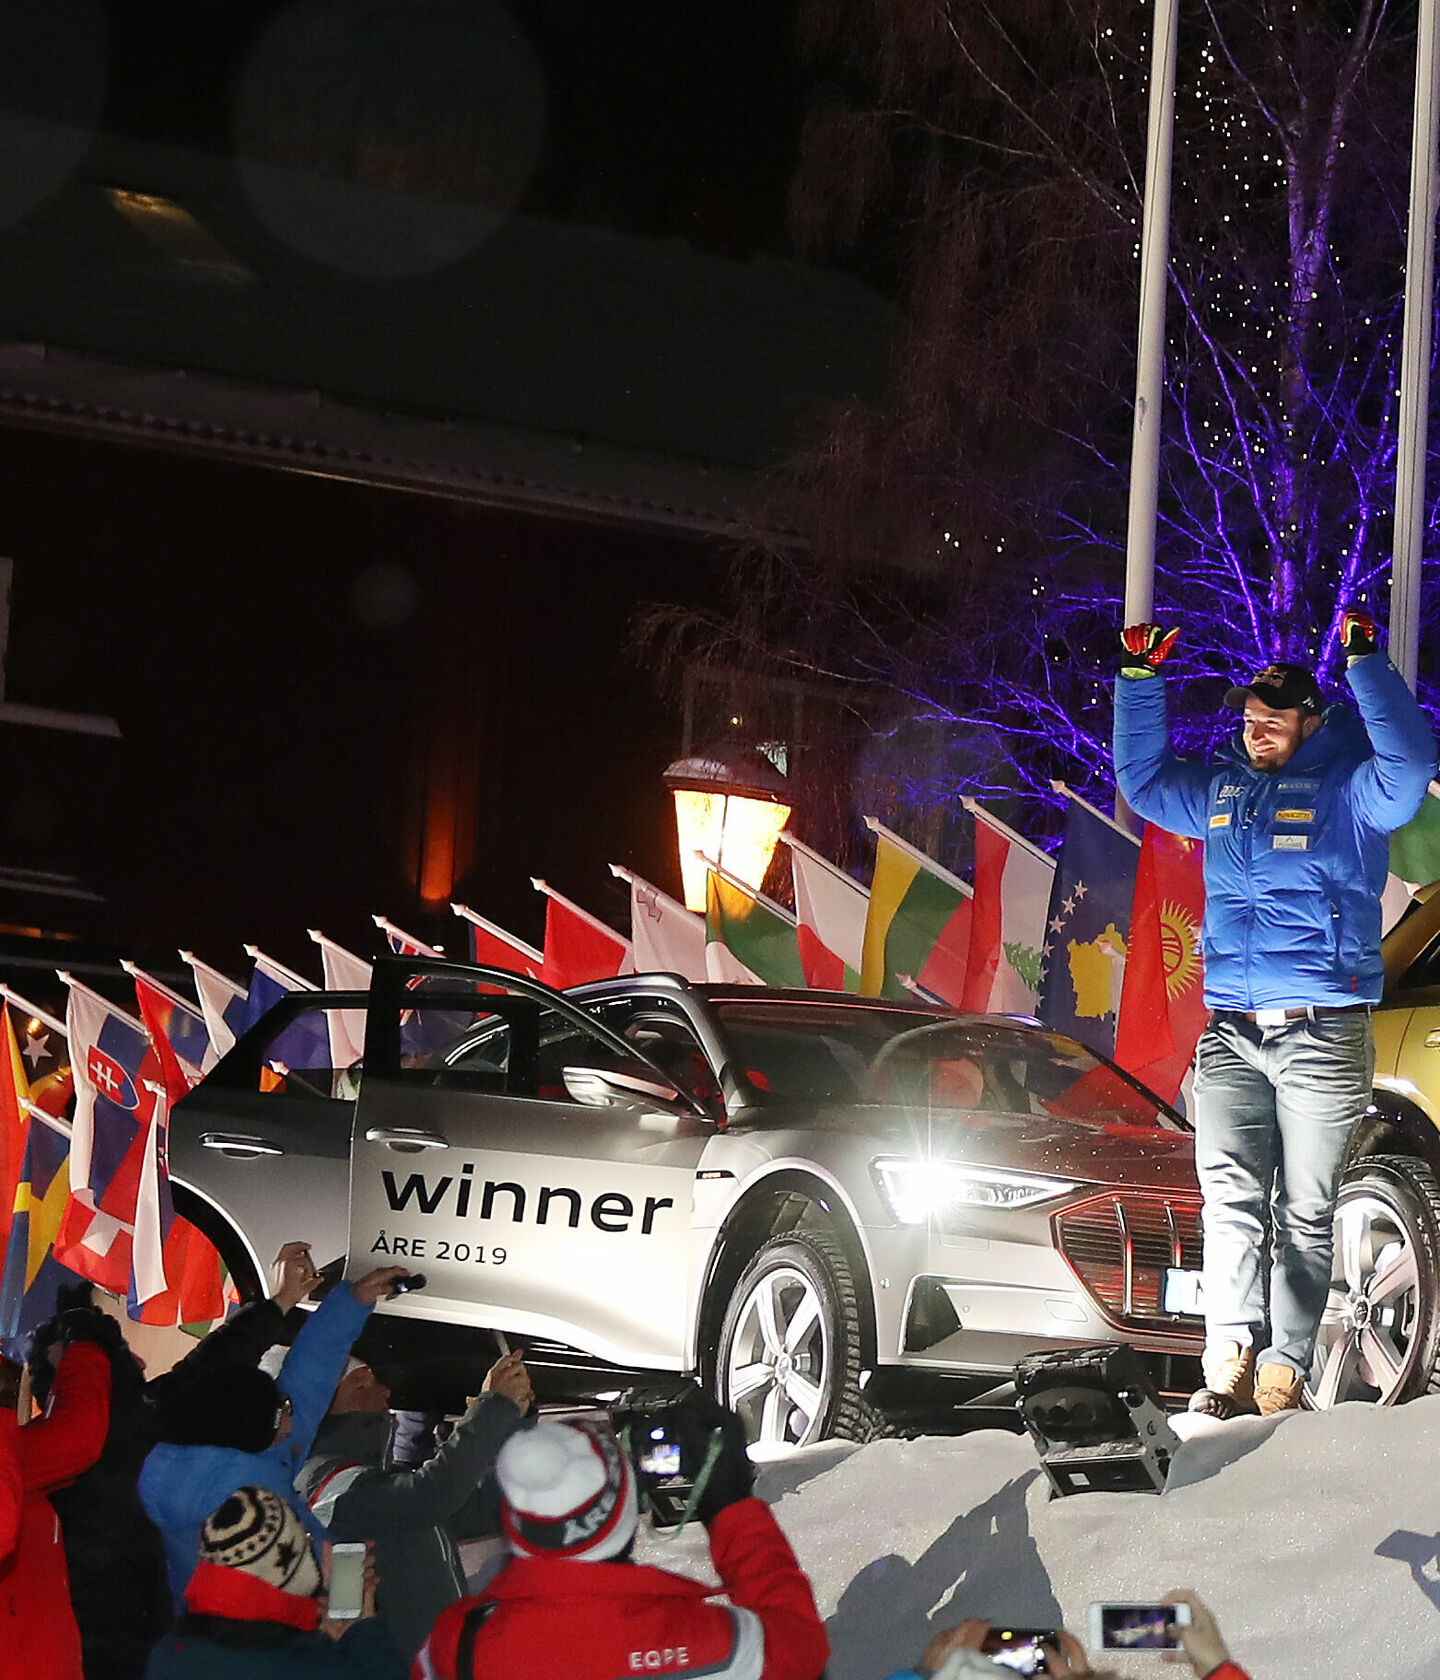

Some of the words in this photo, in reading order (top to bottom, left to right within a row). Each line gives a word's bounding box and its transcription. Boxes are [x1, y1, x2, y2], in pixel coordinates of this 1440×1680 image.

[381, 1163, 674, 1235] winner
[370, 1229, 427, 1258] ÅRE
[435, 1241, 508, 1266] 2019
[629, 1646, 690, 1670] EQPE
